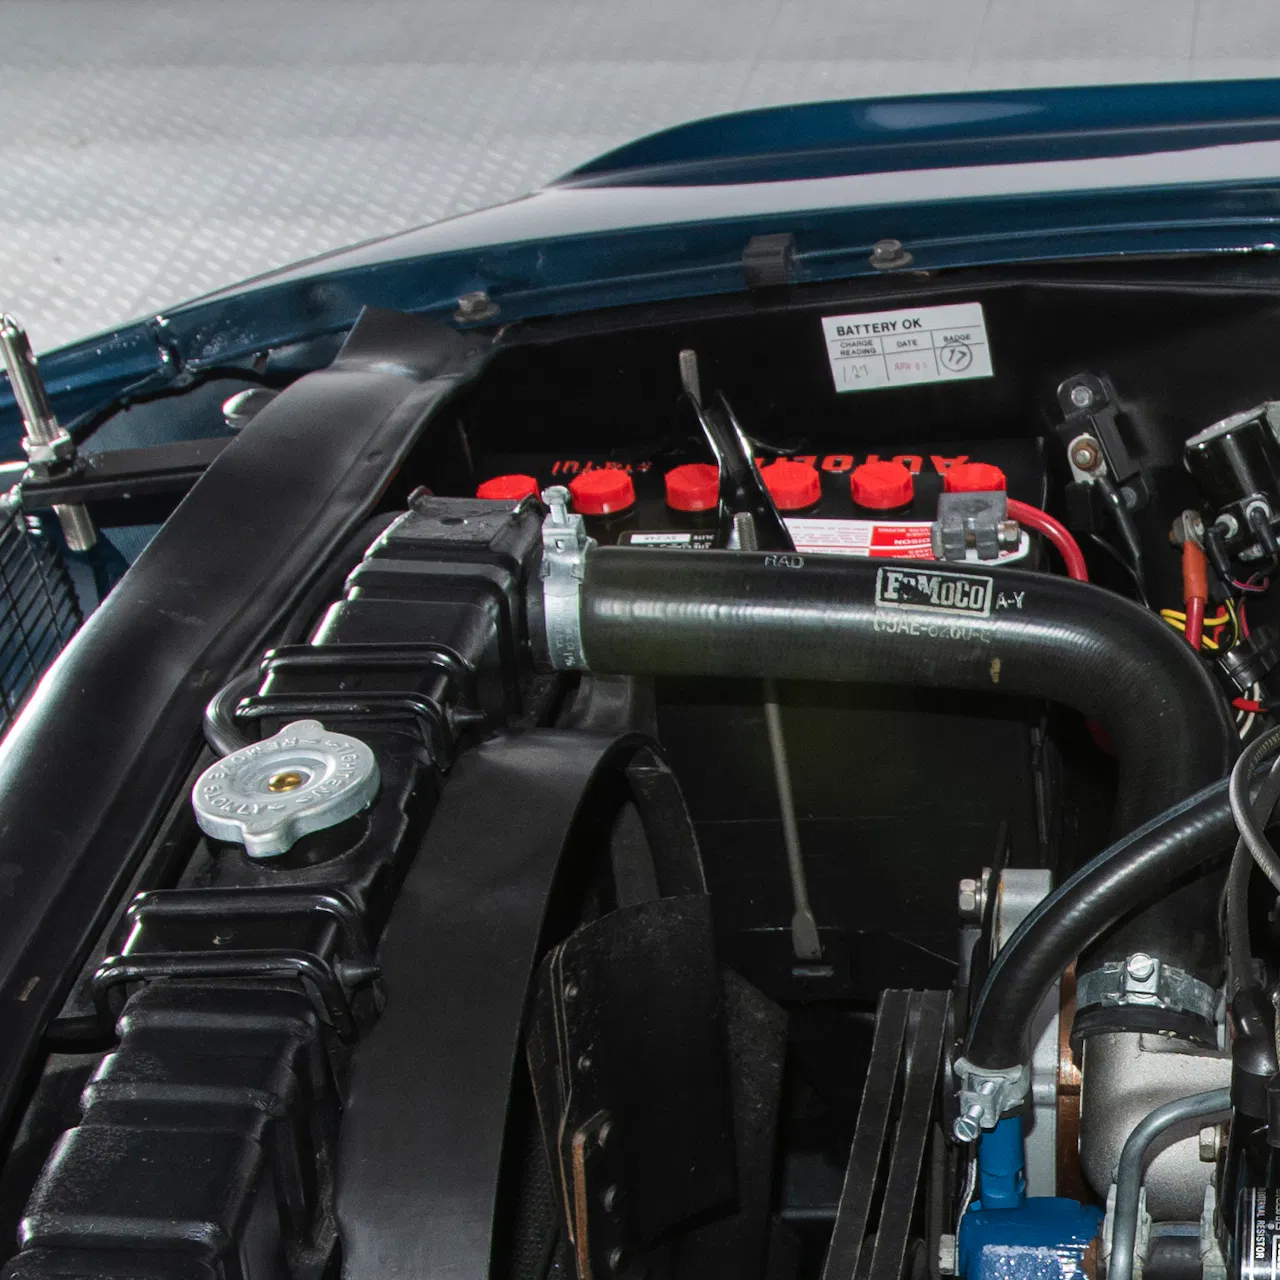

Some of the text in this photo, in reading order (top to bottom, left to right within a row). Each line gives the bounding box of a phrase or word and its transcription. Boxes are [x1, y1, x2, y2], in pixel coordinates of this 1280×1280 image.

[836, 317, 922, 337] BATTERY OK
[943, 333, 972, 343] BADGE
[840, 339, 873, 348] CHARGE
[896, 339, 918, 348] DATE
[840, 347, 877, 356] READING
[1255, 1219, 1265, 1259] RESISTOR
